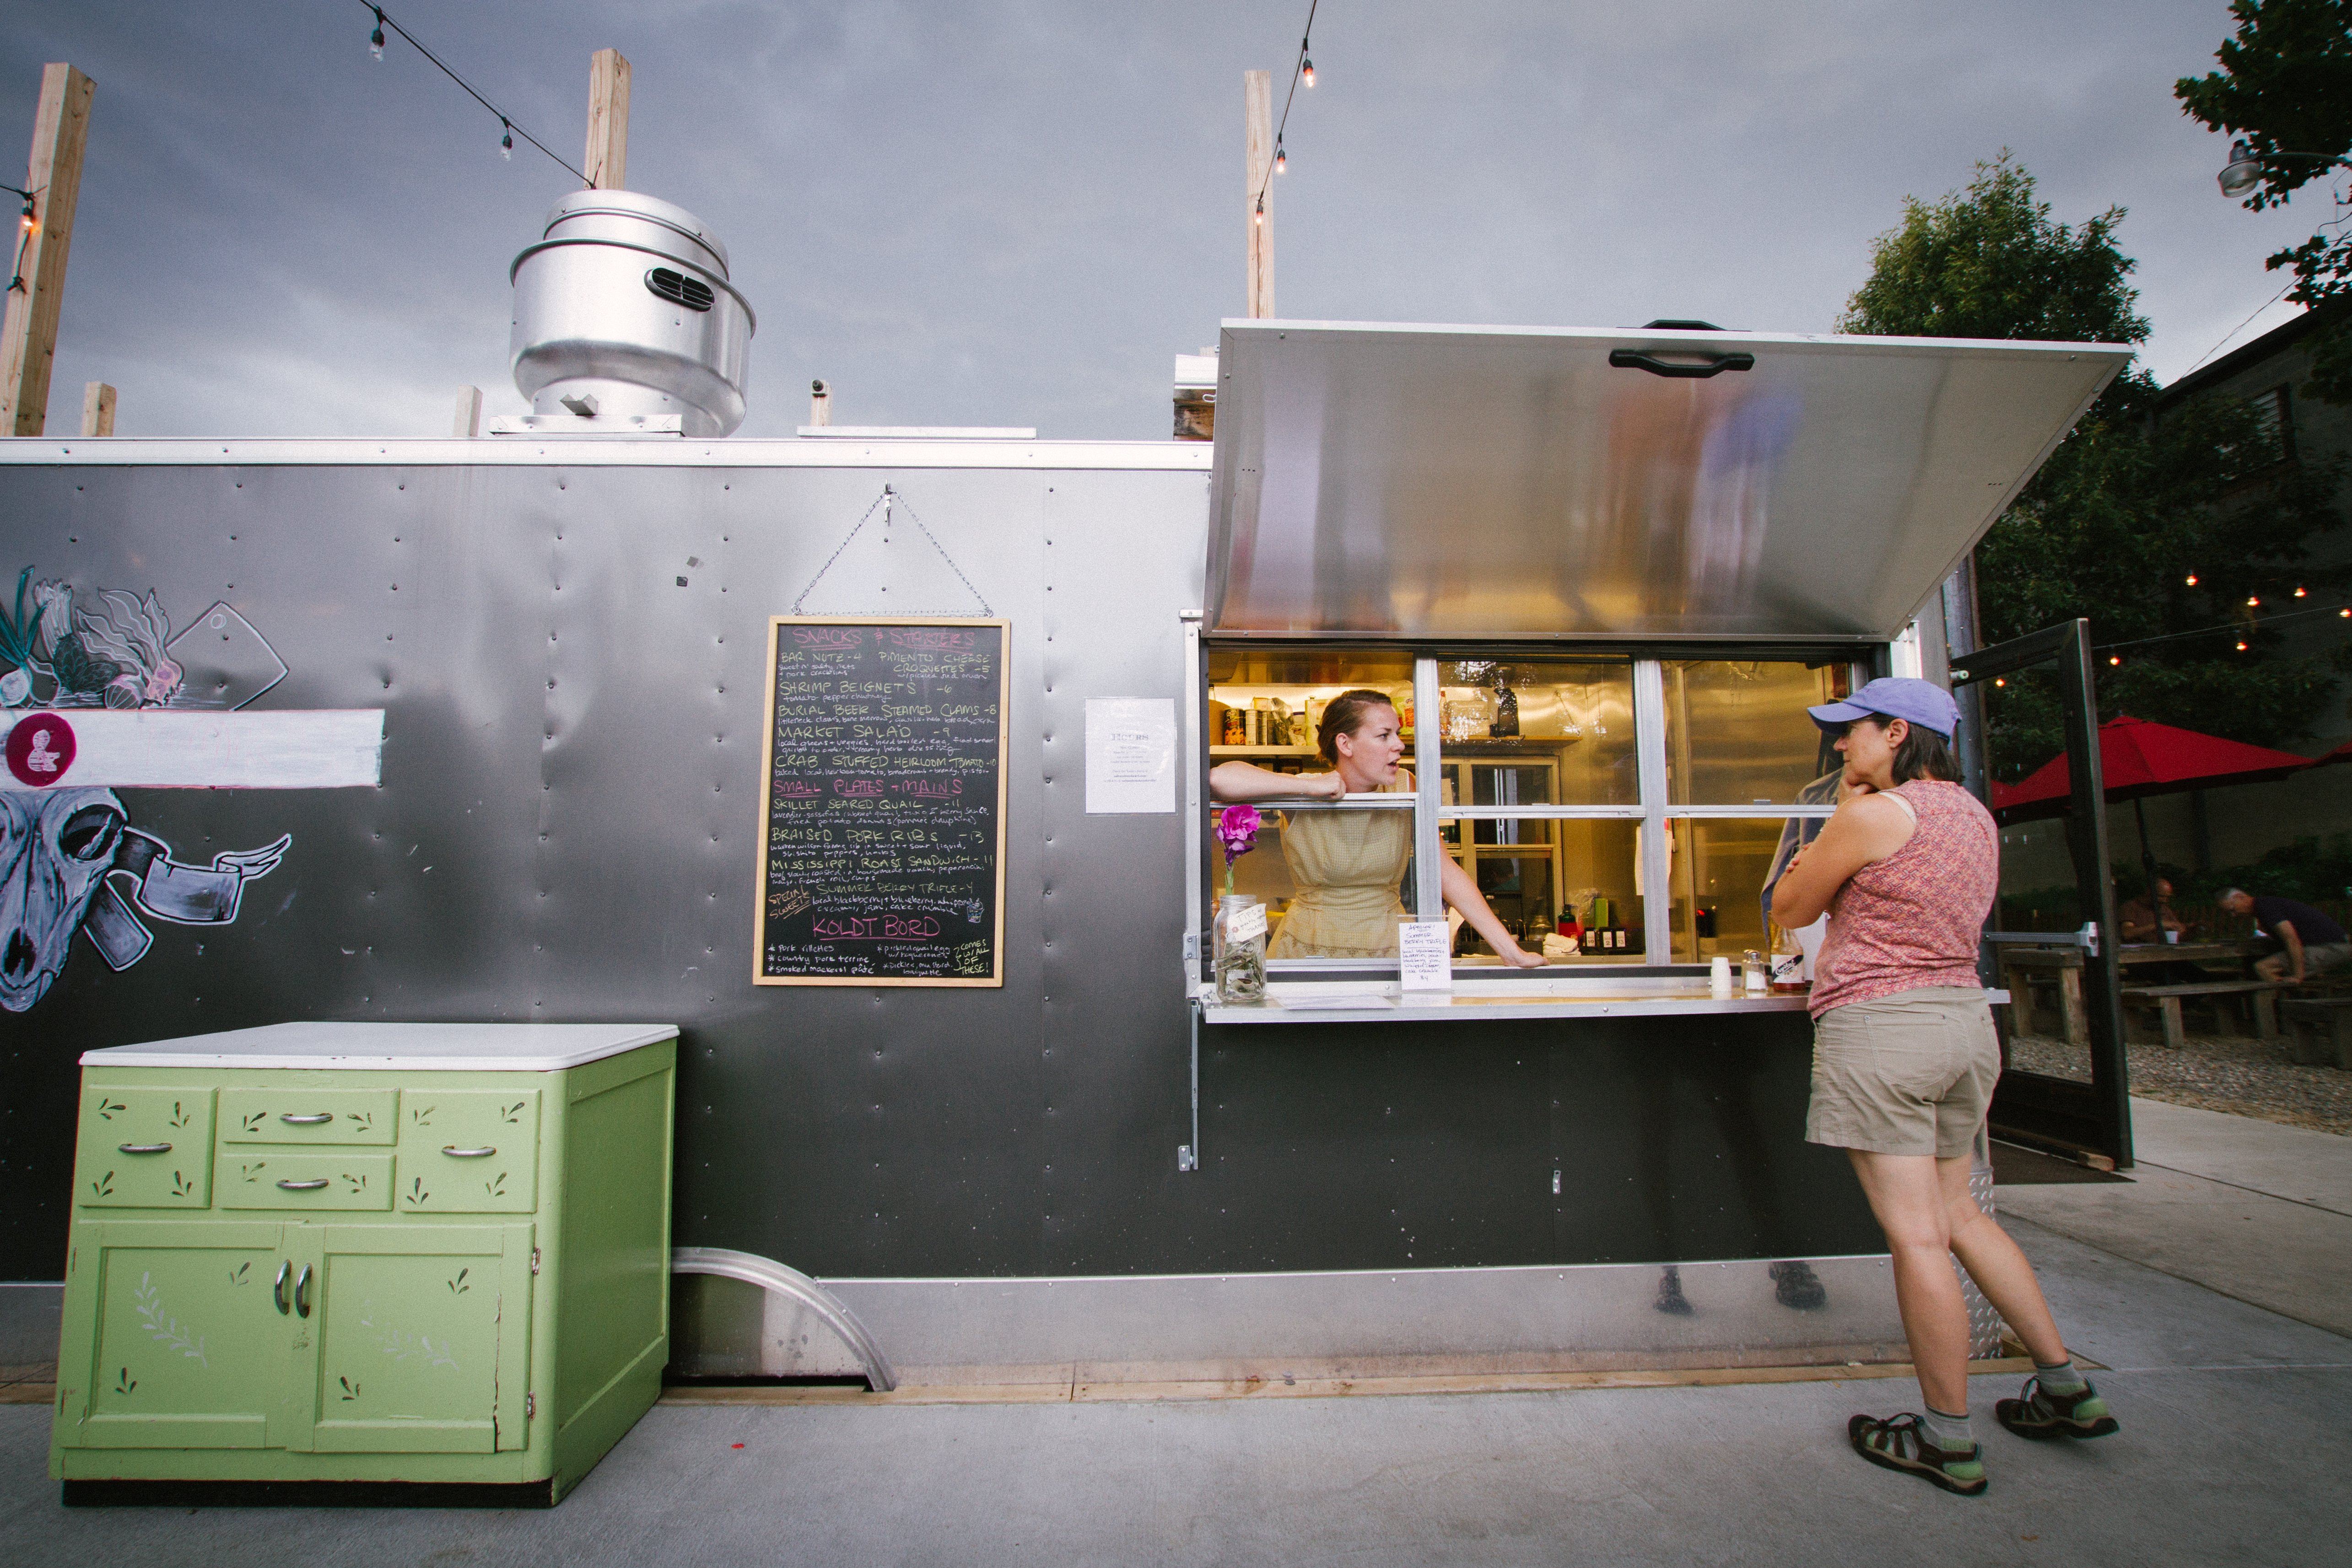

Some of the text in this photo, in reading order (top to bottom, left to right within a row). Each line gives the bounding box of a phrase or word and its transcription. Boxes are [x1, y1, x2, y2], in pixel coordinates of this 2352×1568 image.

[793, 628, 862, 645] SNACKS
[890, 628, 975, 647] STARTERS
[782, 652, 805, 663] BAR
[878, 652, 992, 663] PIMENTO CHEESE
[894, 663, 965, 673] CROQUETTES
[780, 681, 832, 696] SHRIMP
[840, 680, 917, 695] BEIGNETS
[778, 705, 826, 717] BURIAL
[832, 704, 870, 716] BEER
[881, 704, 932, 718] STEAMED
[940, 703, 980, 717] CLAMS
[778, 726, 844, 739] MARKET
[852, 724, 912, 738] SALAD
[777, 739, 798, 747] local
[776, 754, 818, 768] CRAB
[832, 755, 889, 769] STUFFED
[894, 757, 946, 768] HEIRLOOM
[949, 757, 984, 768] TOMATO
[775, 768, 799, 777] baked
[774, 780, 822, 793] SMALL
[834, 779, 884, 793] PLATES
[902, 779, 962, 794] MAINS
[774, 798, 818, 810] SKILLET
[828, 799, 873, 809] SEARED
[879, 799, 924, 810] QUAIL
[817, 818, 851, 828] potato
[771, 827, 832, 841] BRAISED
[845, 829, 886, 843] PORK
[890, 829, 938, 842] RIBS
[771, 855, 971, 871] MISSISSIPPI ROAST SANDWICH
[816, 882, 957, 895] SUMMER BERRY TRIFLE
[917, 904, 959, 916] crumble
[1236, 909, 1257, 921] TIPS
[813, 915, 941, 937] KOLDT BORD
[778, 943, 796, 953] pork
[960, 938, 987, 950] COMES
[934, 946, 950, 955] egg
[777, 954, 810, 965] country
[838, 954, 869, 963] terrine
[964, 955, 980, 965] OF
[776, 964, 807, 974] smoked
